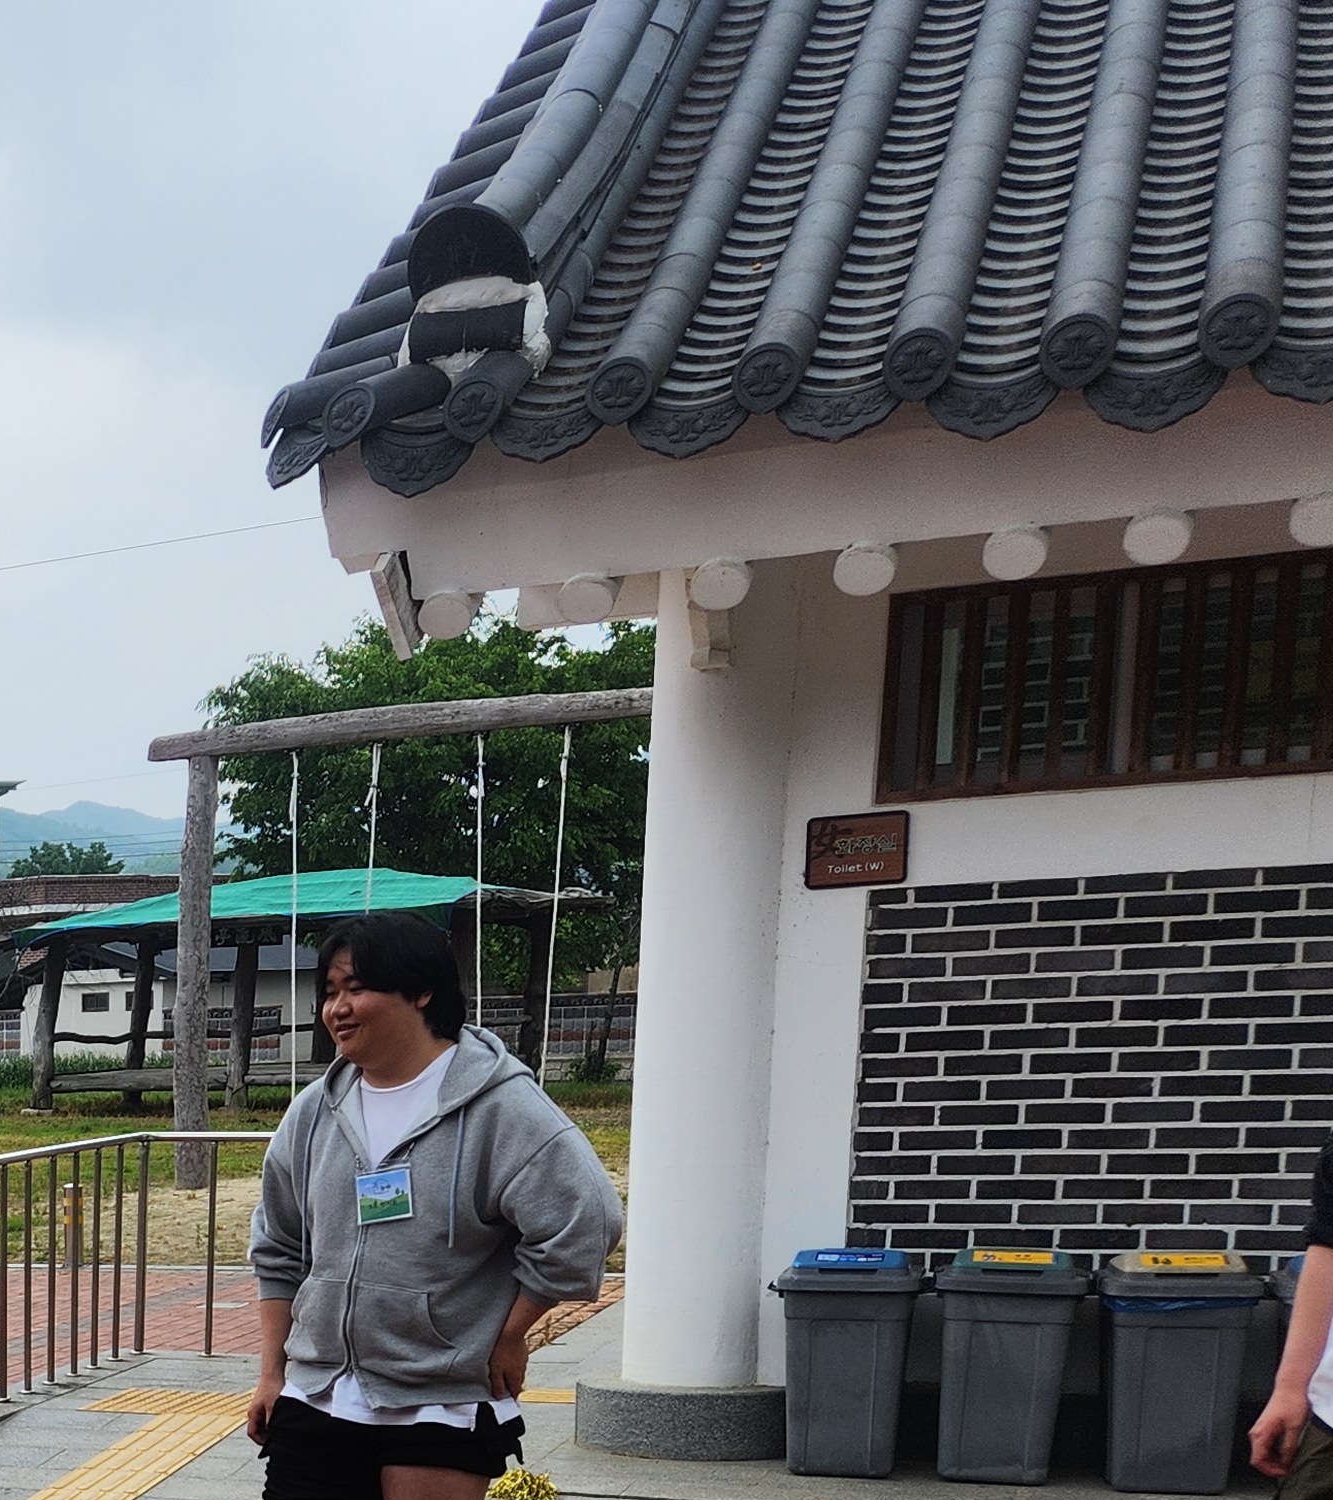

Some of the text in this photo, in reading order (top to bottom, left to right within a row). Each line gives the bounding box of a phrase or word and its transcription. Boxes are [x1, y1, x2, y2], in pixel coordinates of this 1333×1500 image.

[835, 832, 897, 856] 화장실
[827, 861, 884, 874] Toilet (W)
